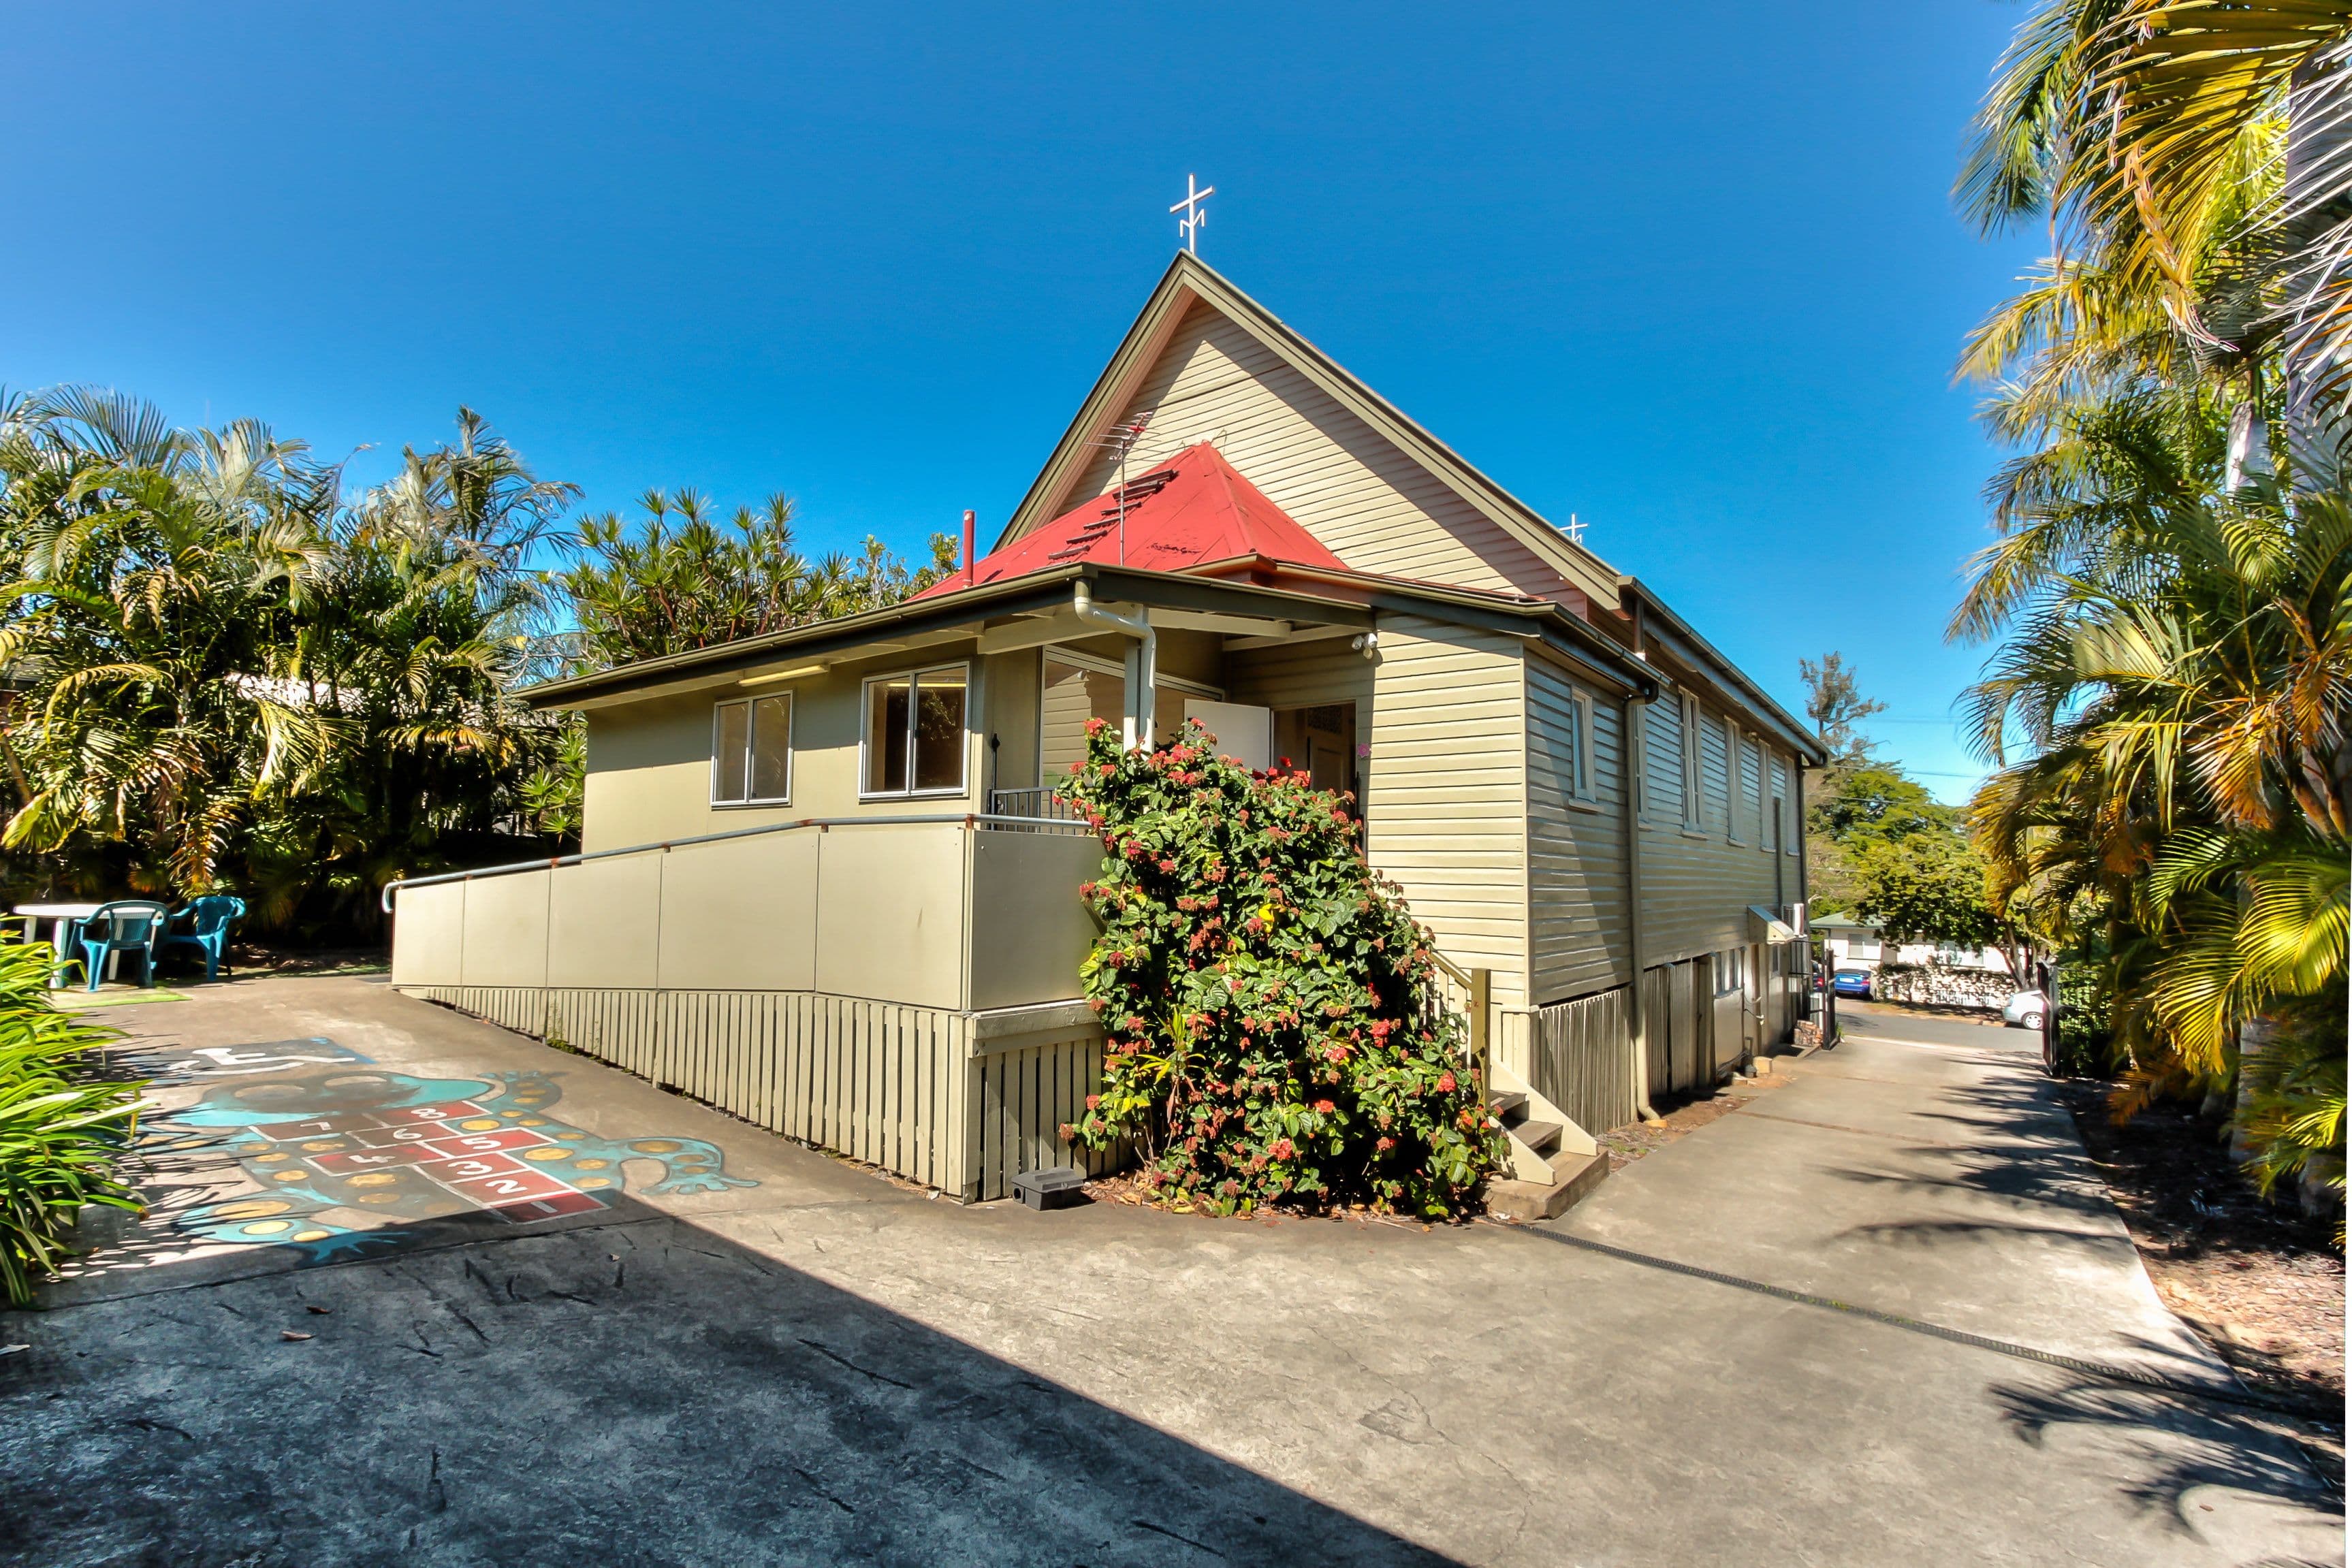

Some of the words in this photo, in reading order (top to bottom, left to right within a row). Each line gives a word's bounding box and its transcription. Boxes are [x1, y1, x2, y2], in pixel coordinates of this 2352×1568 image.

[411, 1108, 447, 1119] 8
[300, 1122, 332, 1130] 7
[393, 1128, 423, 1140] 6
[460, 1136, 502, 1149] 5
[348, 1155, 396, 1164] 4
[447, 1161, 493, 1175] 3
[485, 1179, 528, 1194] 2
[530, 1201, 558, 1213] 1
